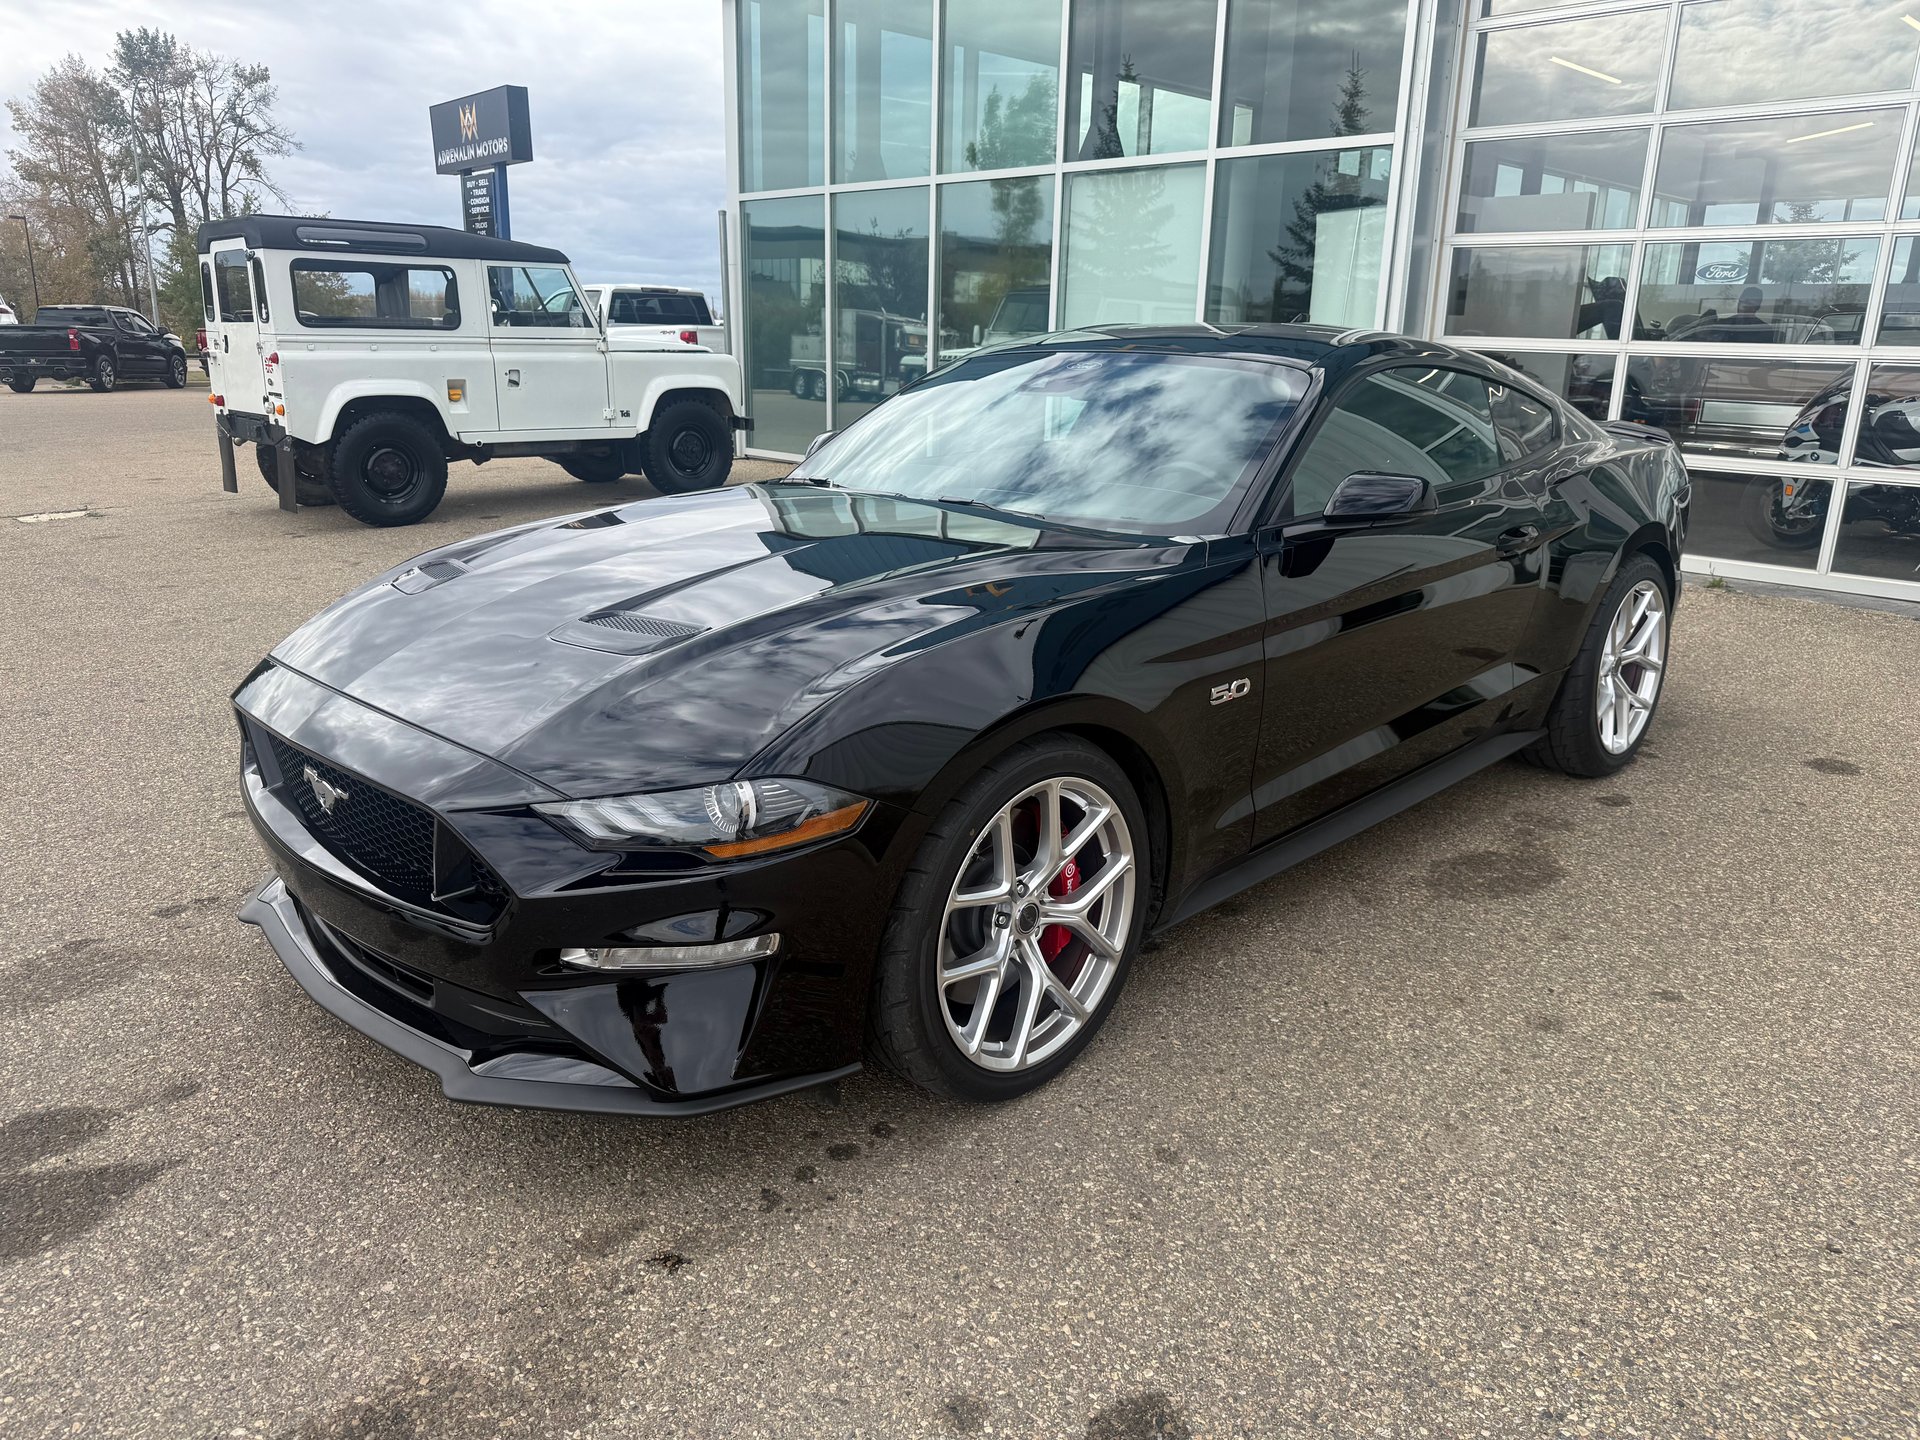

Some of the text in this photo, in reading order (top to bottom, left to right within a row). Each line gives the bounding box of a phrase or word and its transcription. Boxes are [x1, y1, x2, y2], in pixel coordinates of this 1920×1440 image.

[438, 137, 508, 166] ADRENALIN MOTORS
[467, 178, 489, 188] BUY SELL
[472, 188, 487, 196] TRADE
[470, 196, 490, 205] CONSIGN
[471, 205, 490, 214] SERVICE
[1706, 265, 1740, 278] Ford
[620, 410, 631, 418] Tdi
